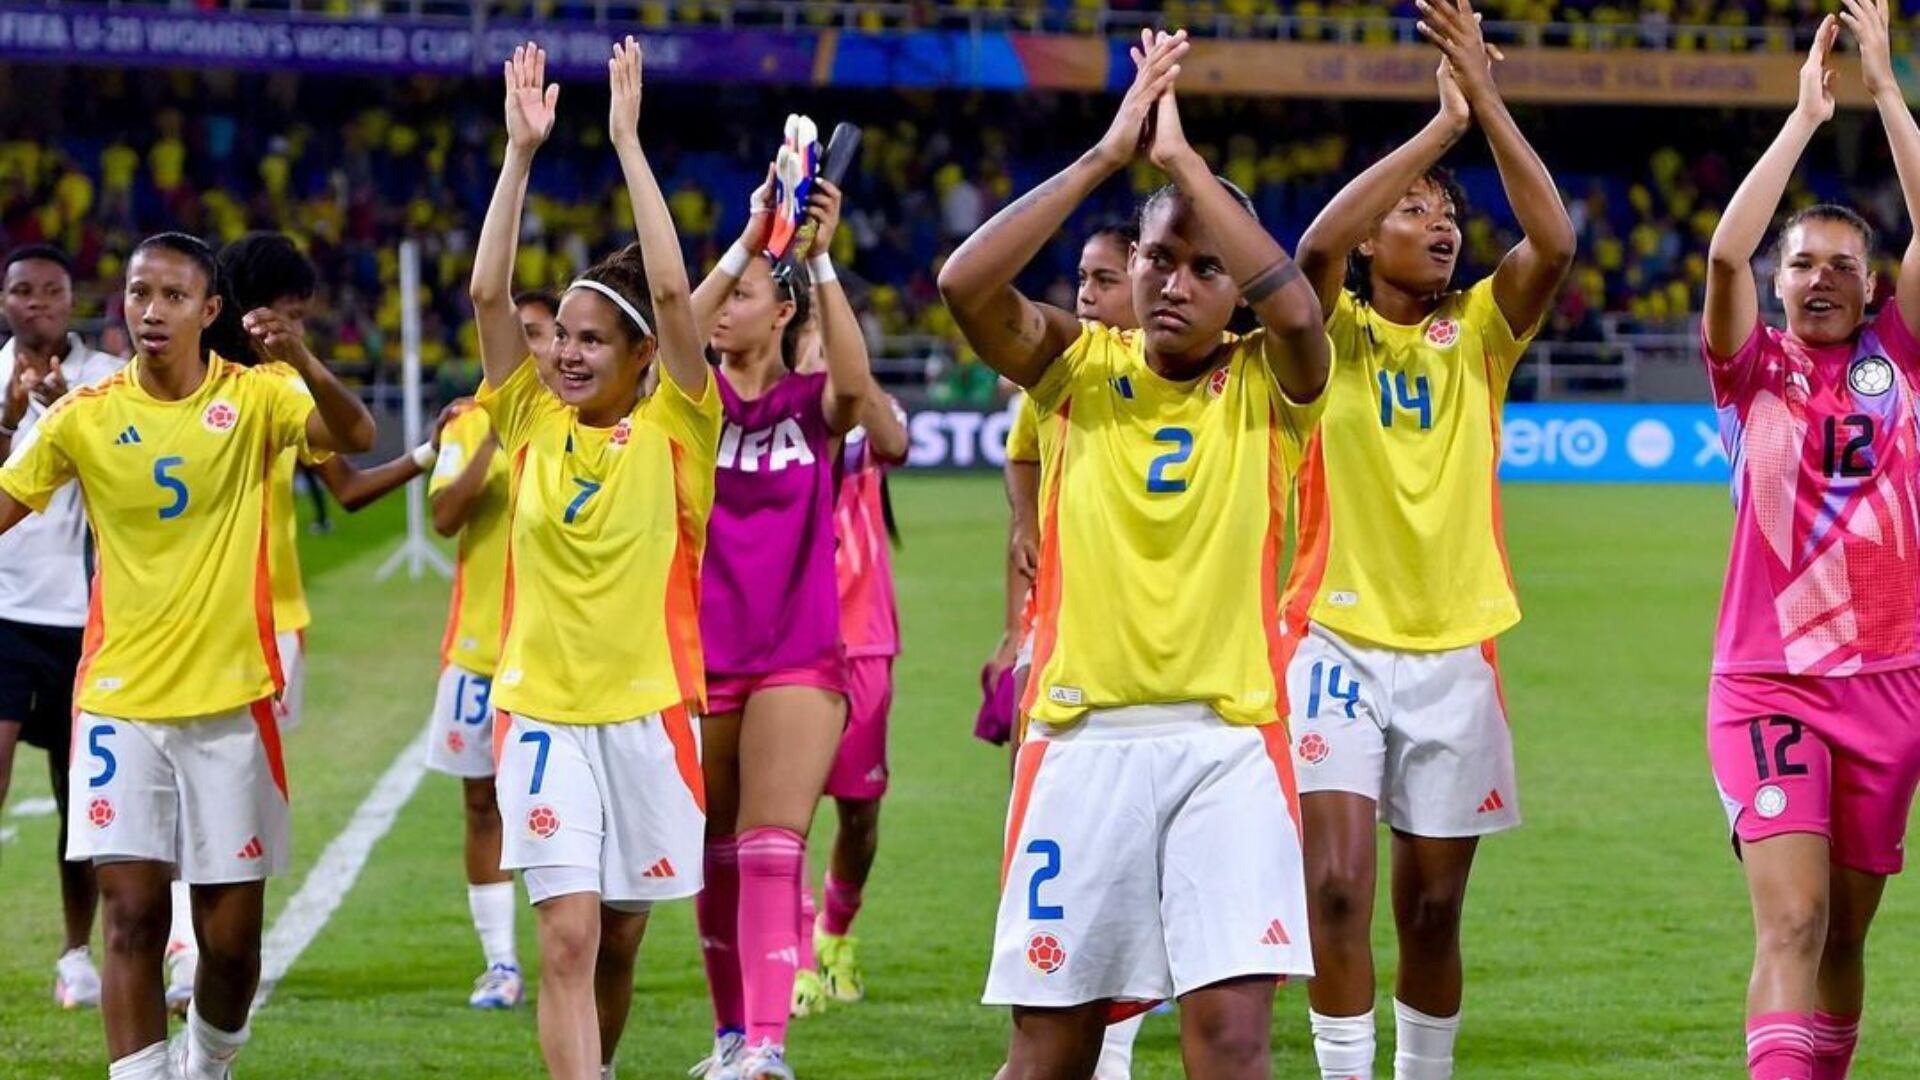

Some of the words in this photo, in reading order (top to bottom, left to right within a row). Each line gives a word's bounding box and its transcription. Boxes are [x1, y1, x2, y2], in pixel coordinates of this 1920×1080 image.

[1, 12, 69, 48] FIFA
[72, 15, 144, 52] U-20
[296, 25, 406, 65] WORLD
[410, 28, 472, 66] CUP
[1376, 367, 1432, 430] 14
[716, 417, 816, 473] IFA
[1146, 427, 1194, 494] 2
[1502, 418, 1608, 468] ero
[1822, 414, 1875, 479] 12
[153, 456, 189, 521] 5
[563, 477, 601, 525] 7
[453, 673, 492, 725] 13
[1307, 661, 1361, 719] 14
[87, 724, 118, 789] 5
[518, 730, 552, 796] 7
[1749, 714, 1809, 781] 12
[1025, 838, 1064, 921] 2
